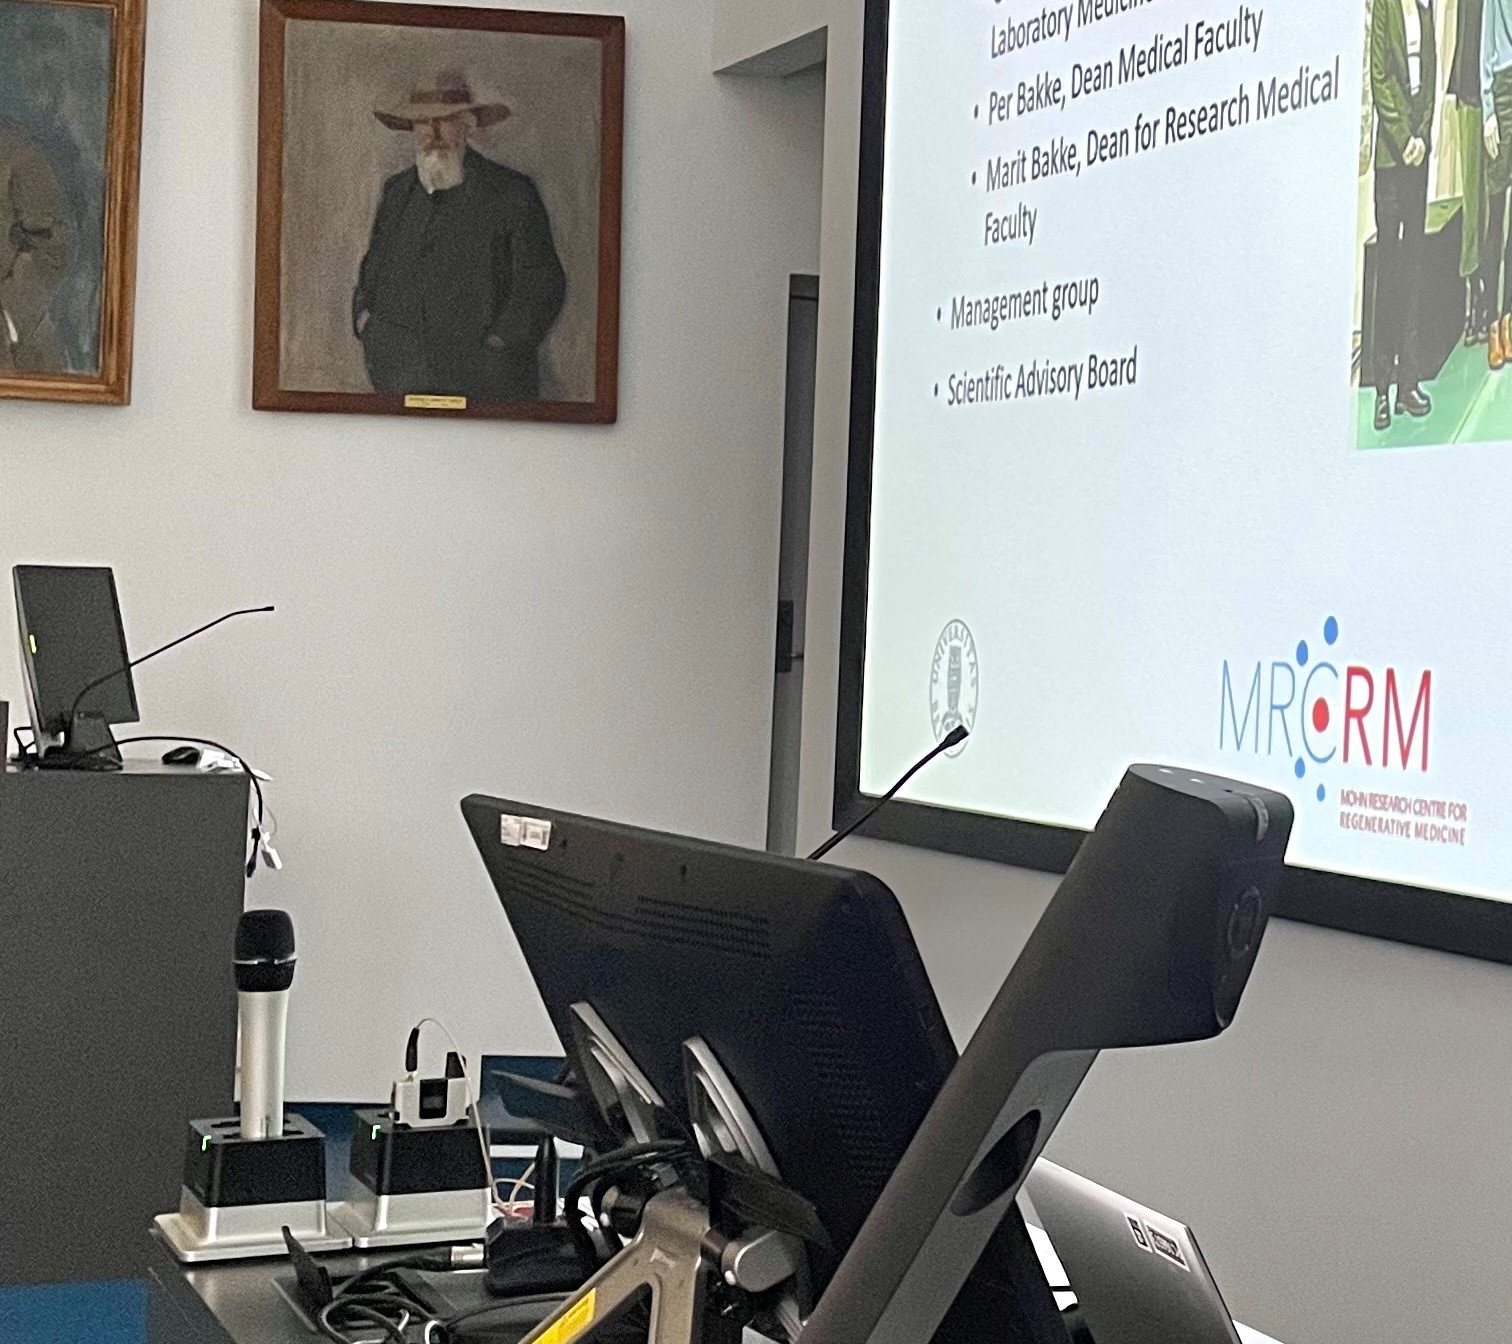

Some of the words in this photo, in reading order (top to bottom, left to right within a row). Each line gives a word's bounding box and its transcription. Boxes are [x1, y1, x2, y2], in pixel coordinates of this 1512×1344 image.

[991, 1, 1074, 59] Laboratory
[988, 90, 1013, 126] Per
[1017, 70, 1066, 113] Bakke,
[1071, 61, 1113, 99] Dean
[1118, 24, 1189, 84] Medical
[1194, 5, 1264, 61] Faculty
[986, 149, 1027, 193] Marit
[1031, 136, 1081, 180] Bakke,
[1086, 125, 1130, 167] Dean
[1134, 114, 1160, 154] for
[1165, 85, 1249, 145] Research
[1256, 55, 1340, 121] Medical
[984, 201, 1038, 246] Faculty
[950, 280, 1048, 330] Management
[1052, 276, 1099, 321] group
[947, 366, 1012, 406] Scientific
[1015, 355, 1084, 400] Advisory
[1087, 344, 1138, 388] Board
[1219, 659, 1432, 773] MRCRM
[1340, 789, 1368, 806] MOHN
[1368, 792, 1412, 813] RESEARCH
[1413, 798, 1446, 819] CENTRE
[1448, 801, 1467, 822] FOR
[1340, 811, 1411, 838] REGENERATIVE
[1414, 822, 1465, 846] MEDICINE
